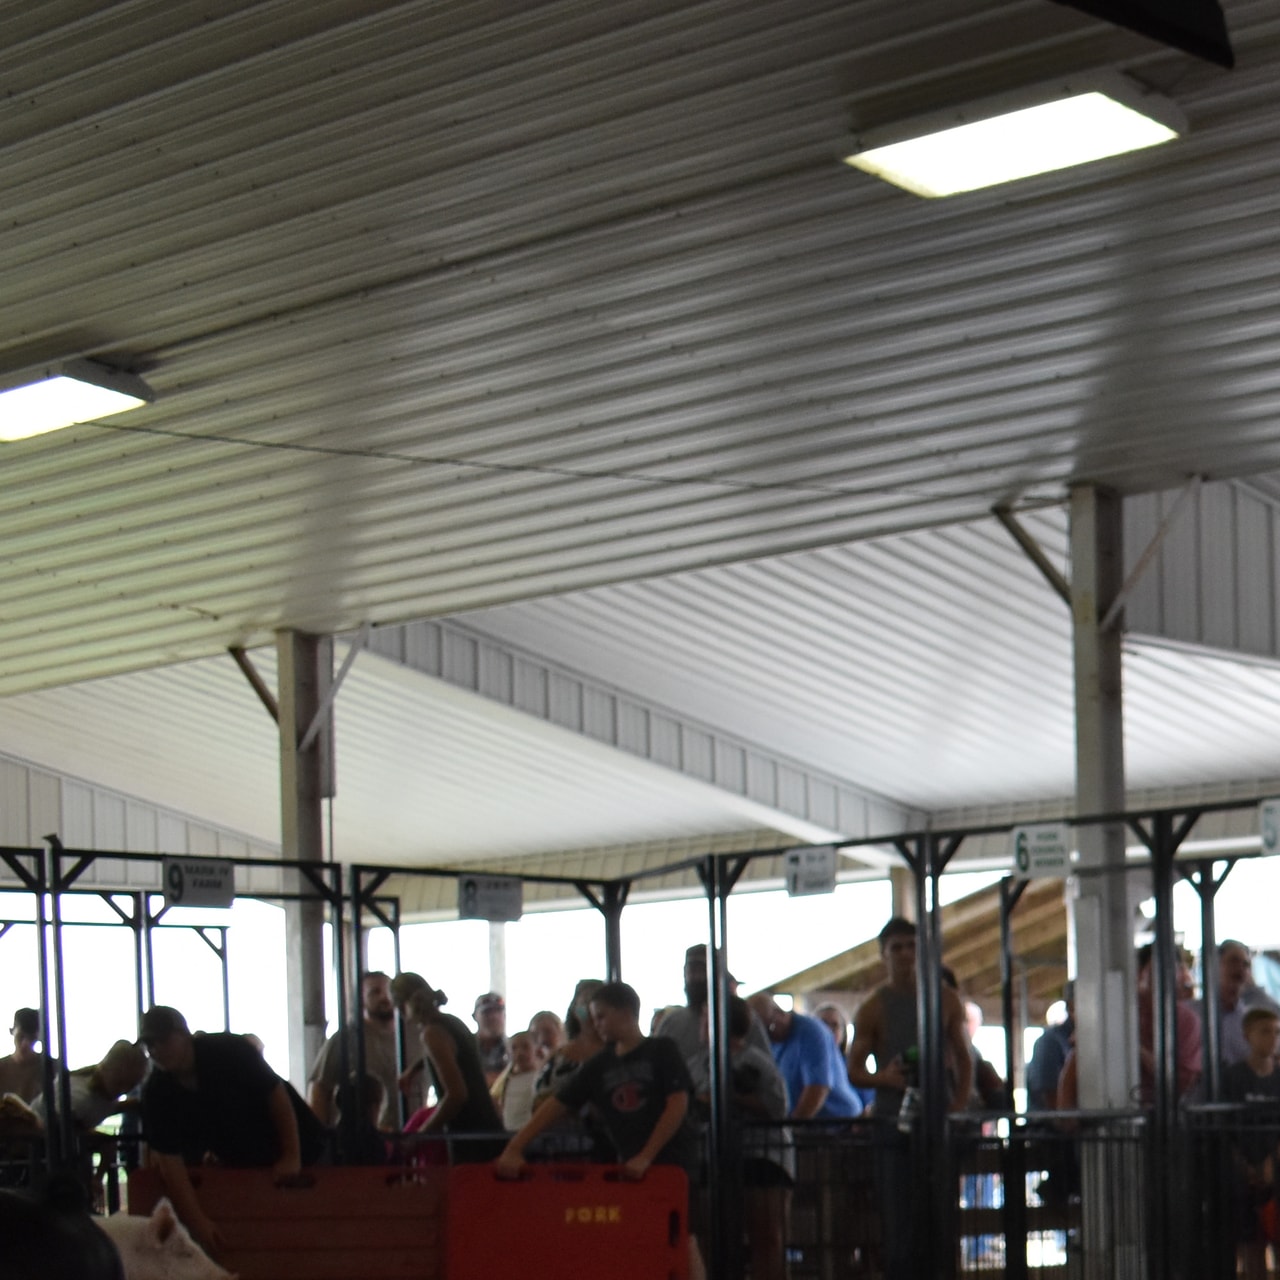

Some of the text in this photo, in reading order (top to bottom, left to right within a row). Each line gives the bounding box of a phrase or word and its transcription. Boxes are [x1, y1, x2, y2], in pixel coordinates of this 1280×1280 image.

[1016, 831, 1030, 873] 6
[168, 862, 184, 904] 9
[464, 879, 479, 915] 8
[564, 1206, 621, 1224] PORK
